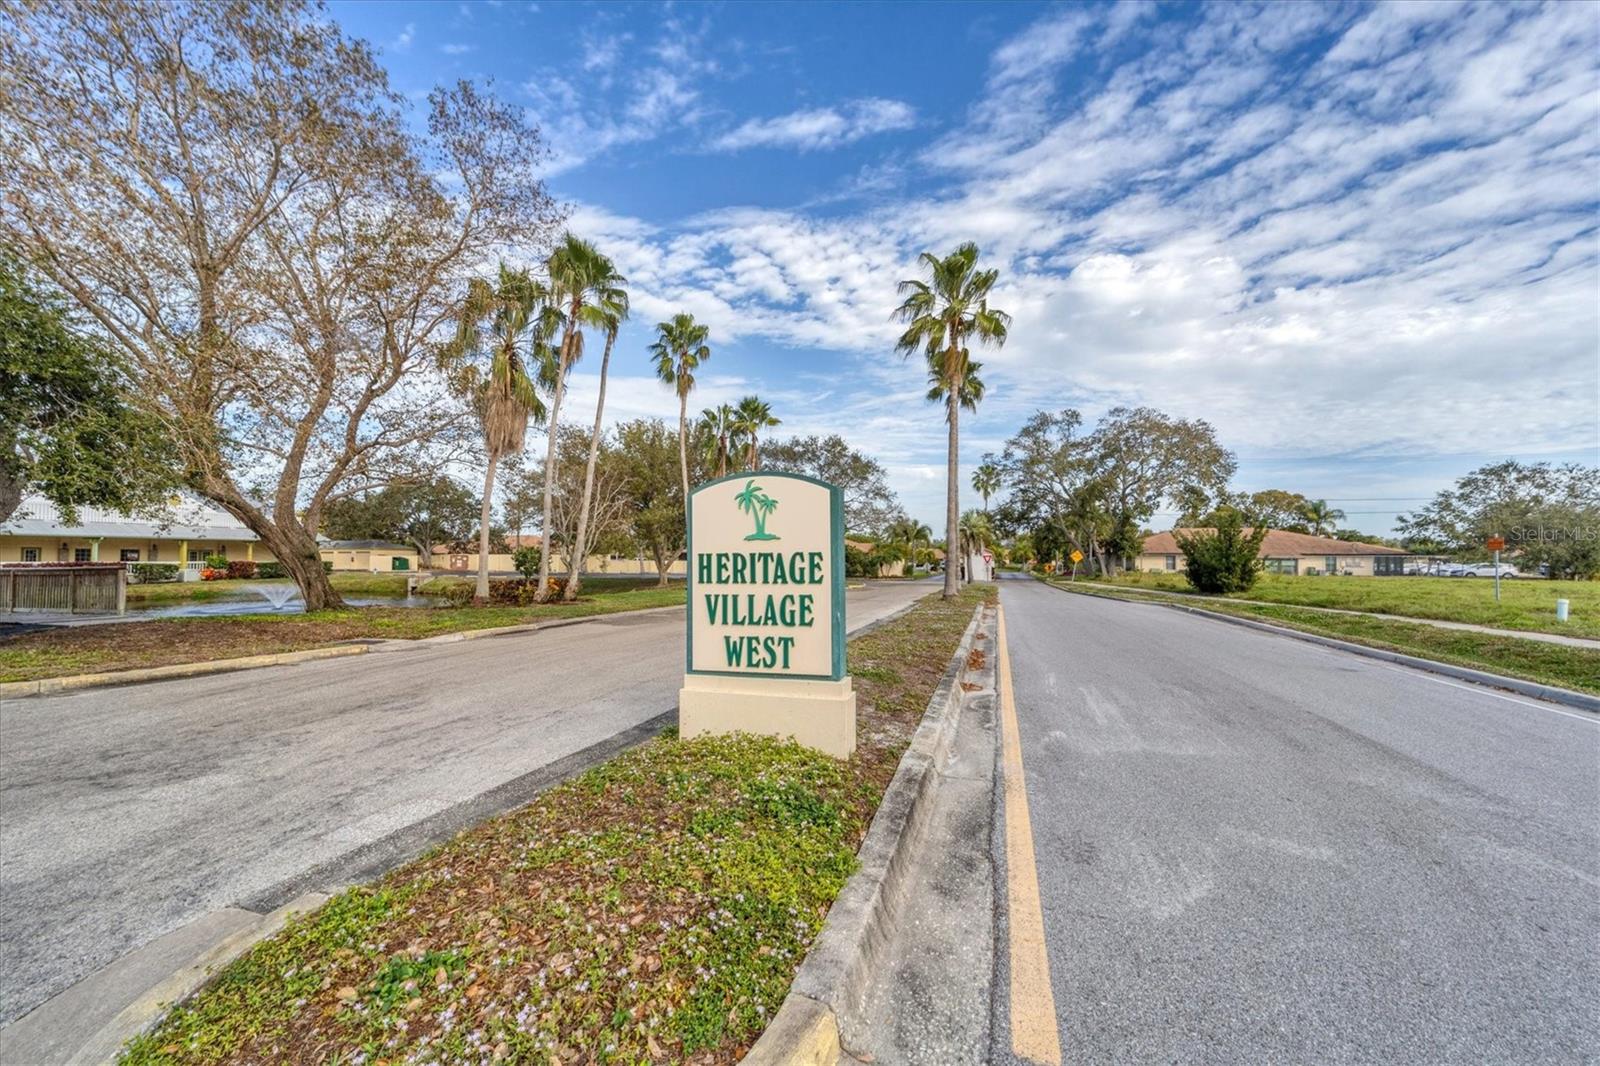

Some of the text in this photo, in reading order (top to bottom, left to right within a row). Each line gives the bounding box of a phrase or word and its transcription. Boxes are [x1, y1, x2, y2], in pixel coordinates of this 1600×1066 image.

[698, 552, 824, 585] HERITAGE
[705, 594, 815, 627] VILLAGE
[724, 636, 795, 669] WEST
